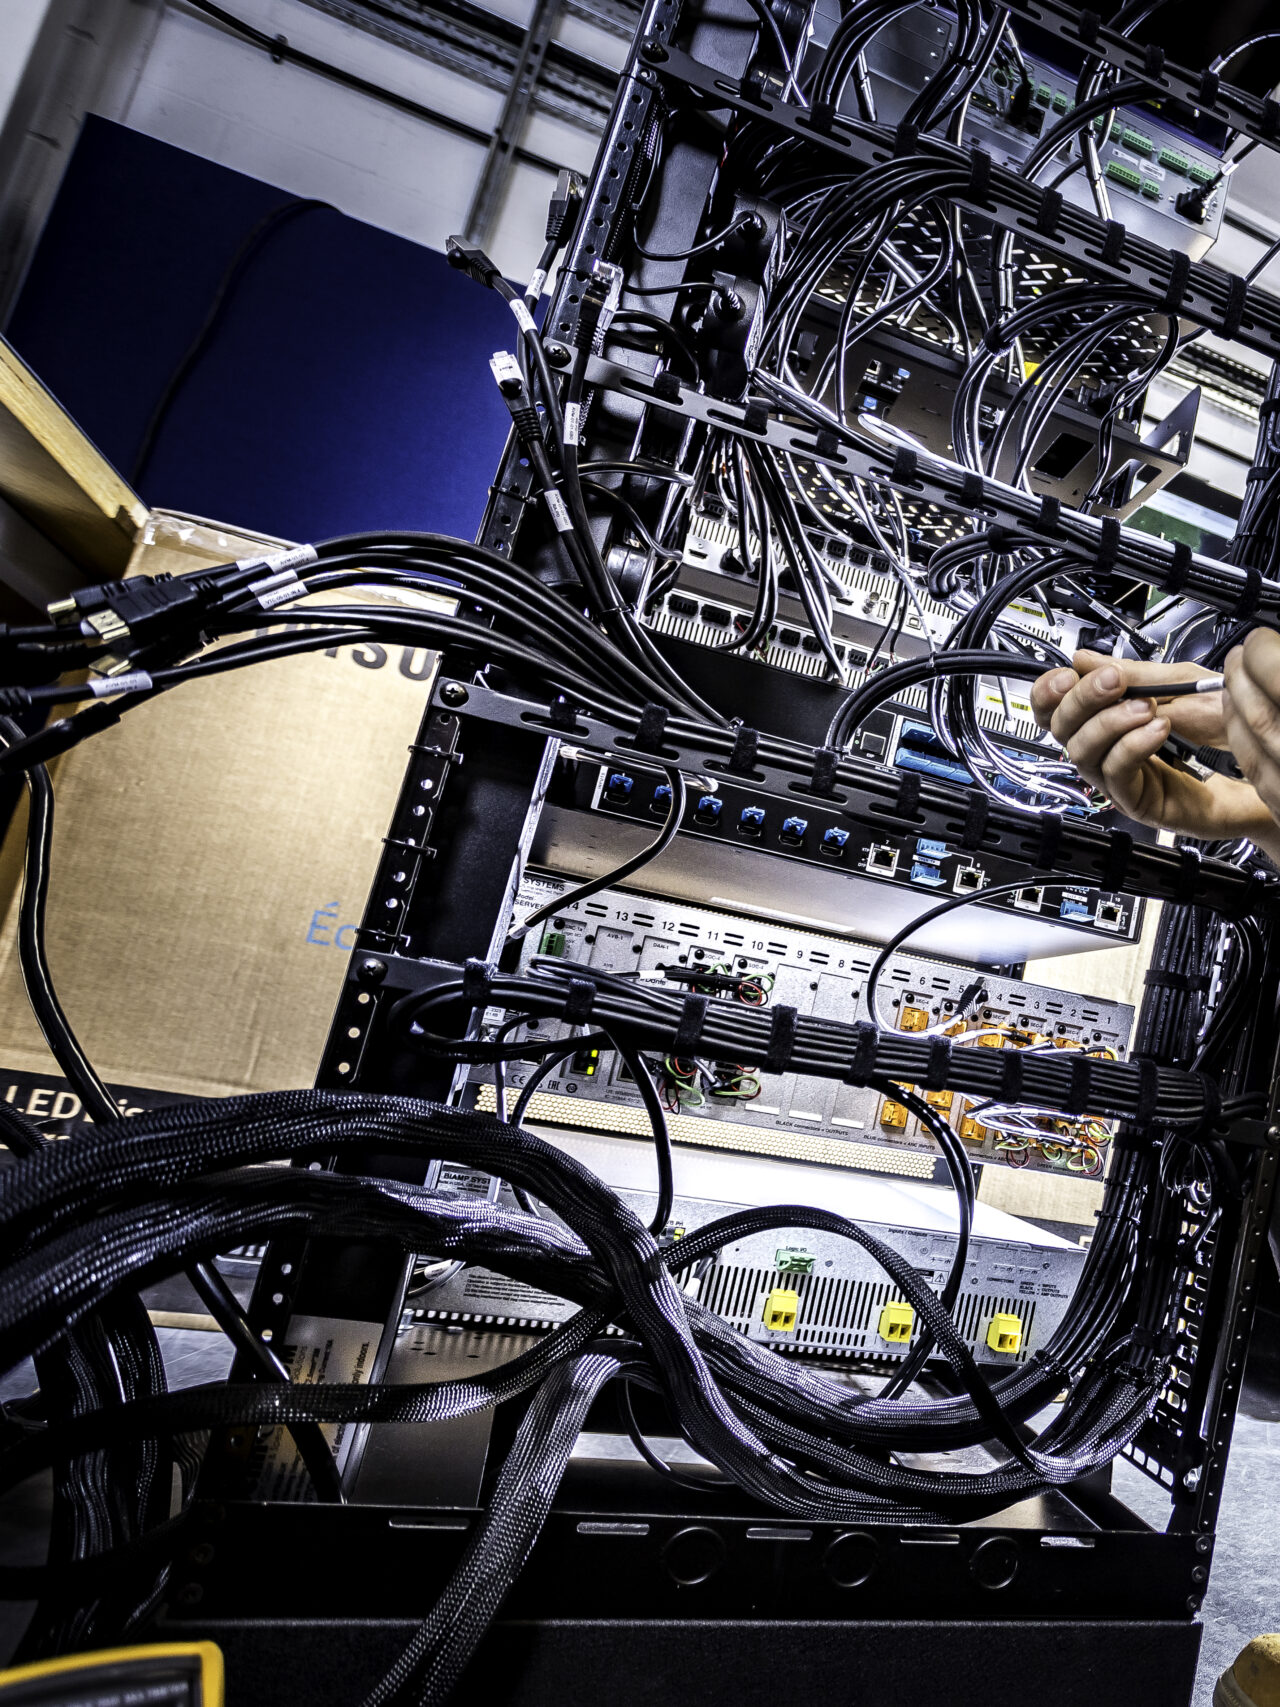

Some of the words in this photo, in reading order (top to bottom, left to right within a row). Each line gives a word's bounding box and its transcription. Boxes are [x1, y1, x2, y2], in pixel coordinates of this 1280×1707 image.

[523, 877, 565, 892] SYSTEMS
[615, 911, 629, 922] 13
[661, 921, 675, 932] 12
[606, 933, 624, 941] AVB-1
[707, 930, 719, 941] 11
[751, 940, 764, 951] 10
[796, 950, 804, 959] 9
[838, 959, 845, 968] 8
[879, 968, 886, 977] 7
[919, 976, 926, 985] 6
[958, 984, 965, 994] 5
[996, 993, 1003, 1002] 4
[1033, 1001, 1040, 1010] 3
[1070, 1009, 1077, 1018] 2
[1106, 1016, 1112, 1025] 1
[793, 1123, 821, 1132] connectors
[825, 1127, 849, 1136] OUTPUTS
[443, 1172, 470, 1181] BIAMP
[355, 1341, 370, 1369] indoors.
